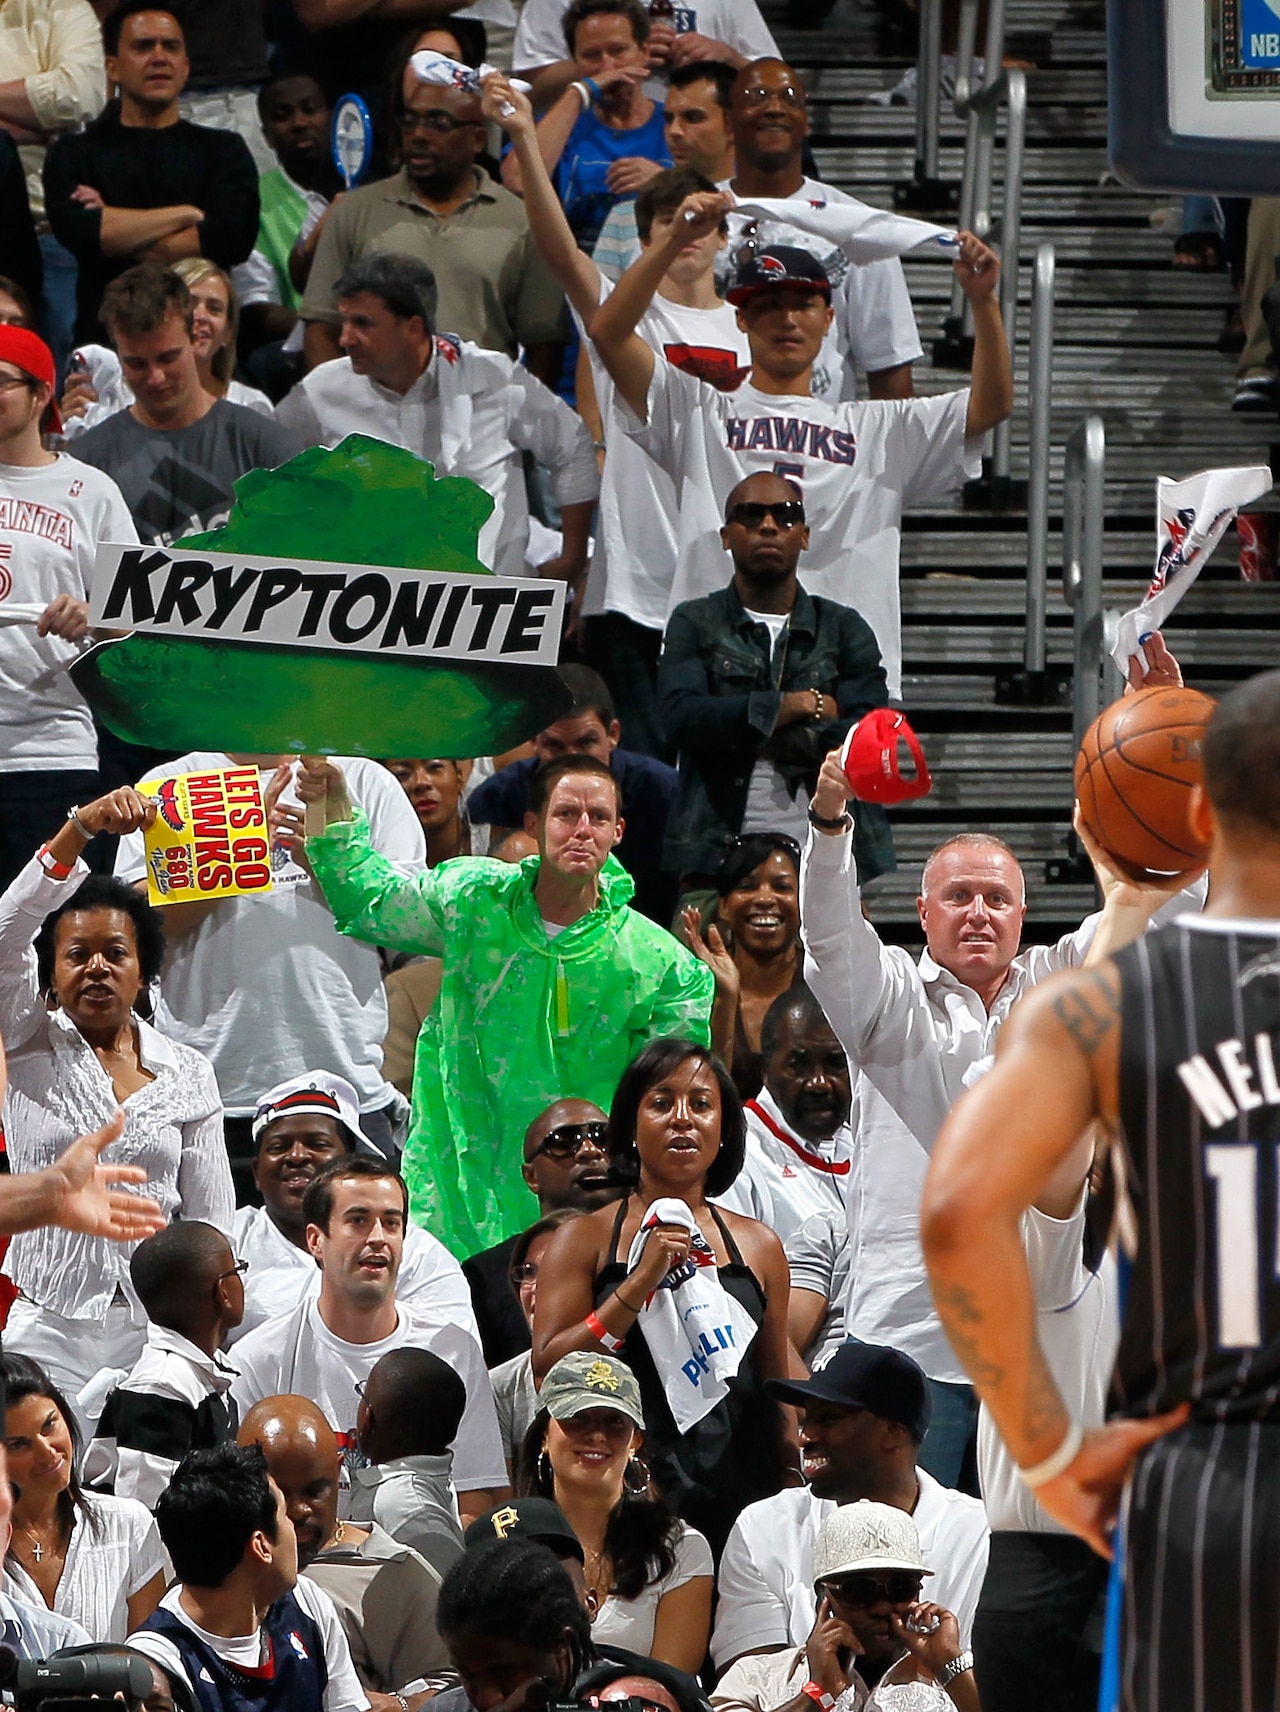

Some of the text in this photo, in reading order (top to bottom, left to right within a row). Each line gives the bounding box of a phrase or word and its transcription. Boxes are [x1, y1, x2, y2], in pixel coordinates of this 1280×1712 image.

[727, 417, 857, 466] HAWKS
[101, 549, 555, 655] KRYPTONITE
[165, 846, 189, 889] 680
[186, 774, 233, 892] HAWKS
[223, 768, 271, 890] LETS GO
[491, 1505, 520, 1539] P
